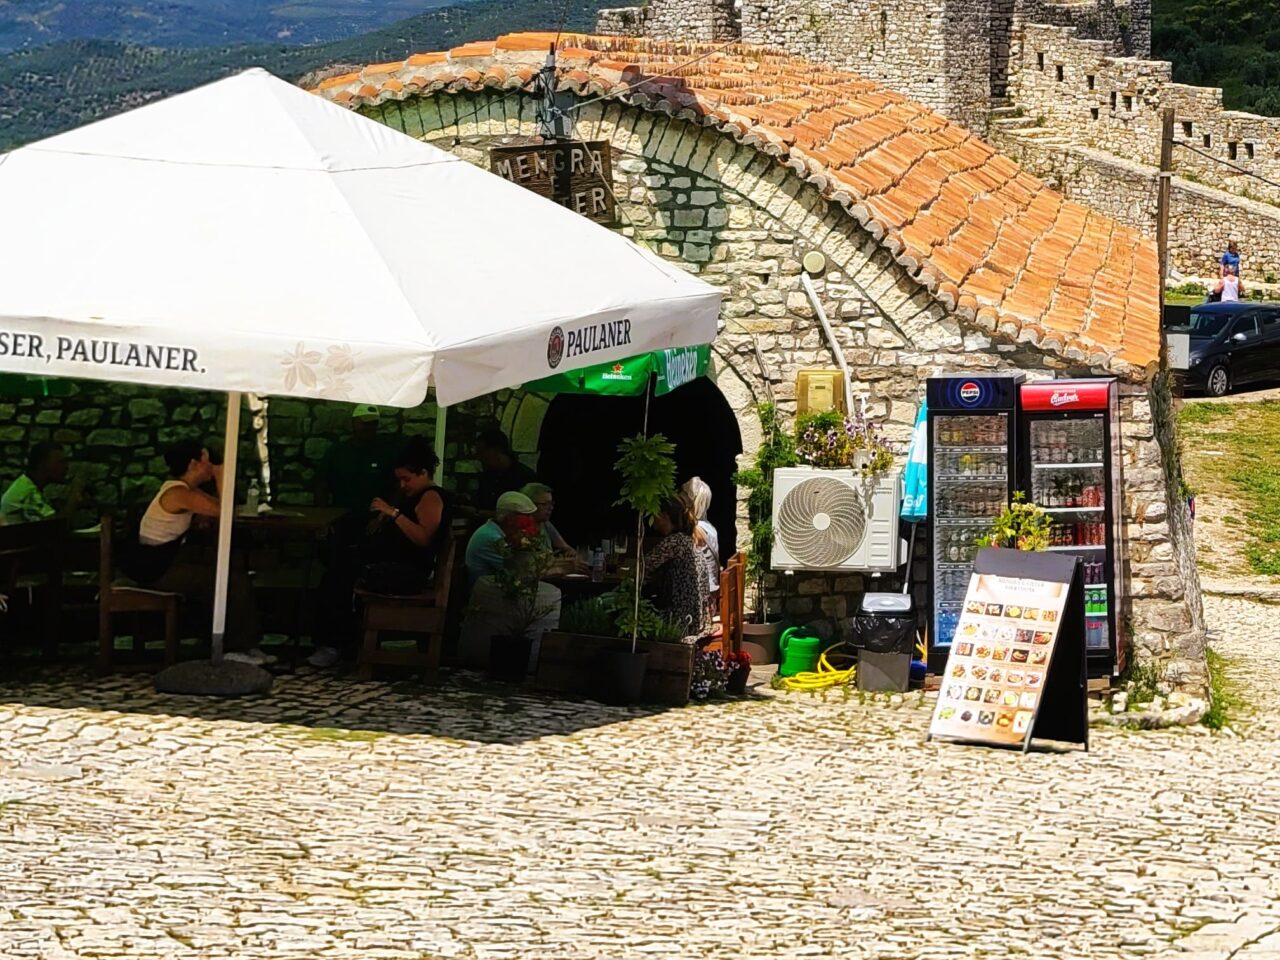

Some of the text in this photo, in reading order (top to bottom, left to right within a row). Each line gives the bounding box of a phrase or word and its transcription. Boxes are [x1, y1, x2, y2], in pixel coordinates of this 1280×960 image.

[496, 149, 603, 181] MENGRA
[56, 337, 206, 373] PAULANER.
[566, 319, 632, 358] PAULANER
[601, 373, 632, 381] Heineken
[665, 347, 698, 388] Heineken
